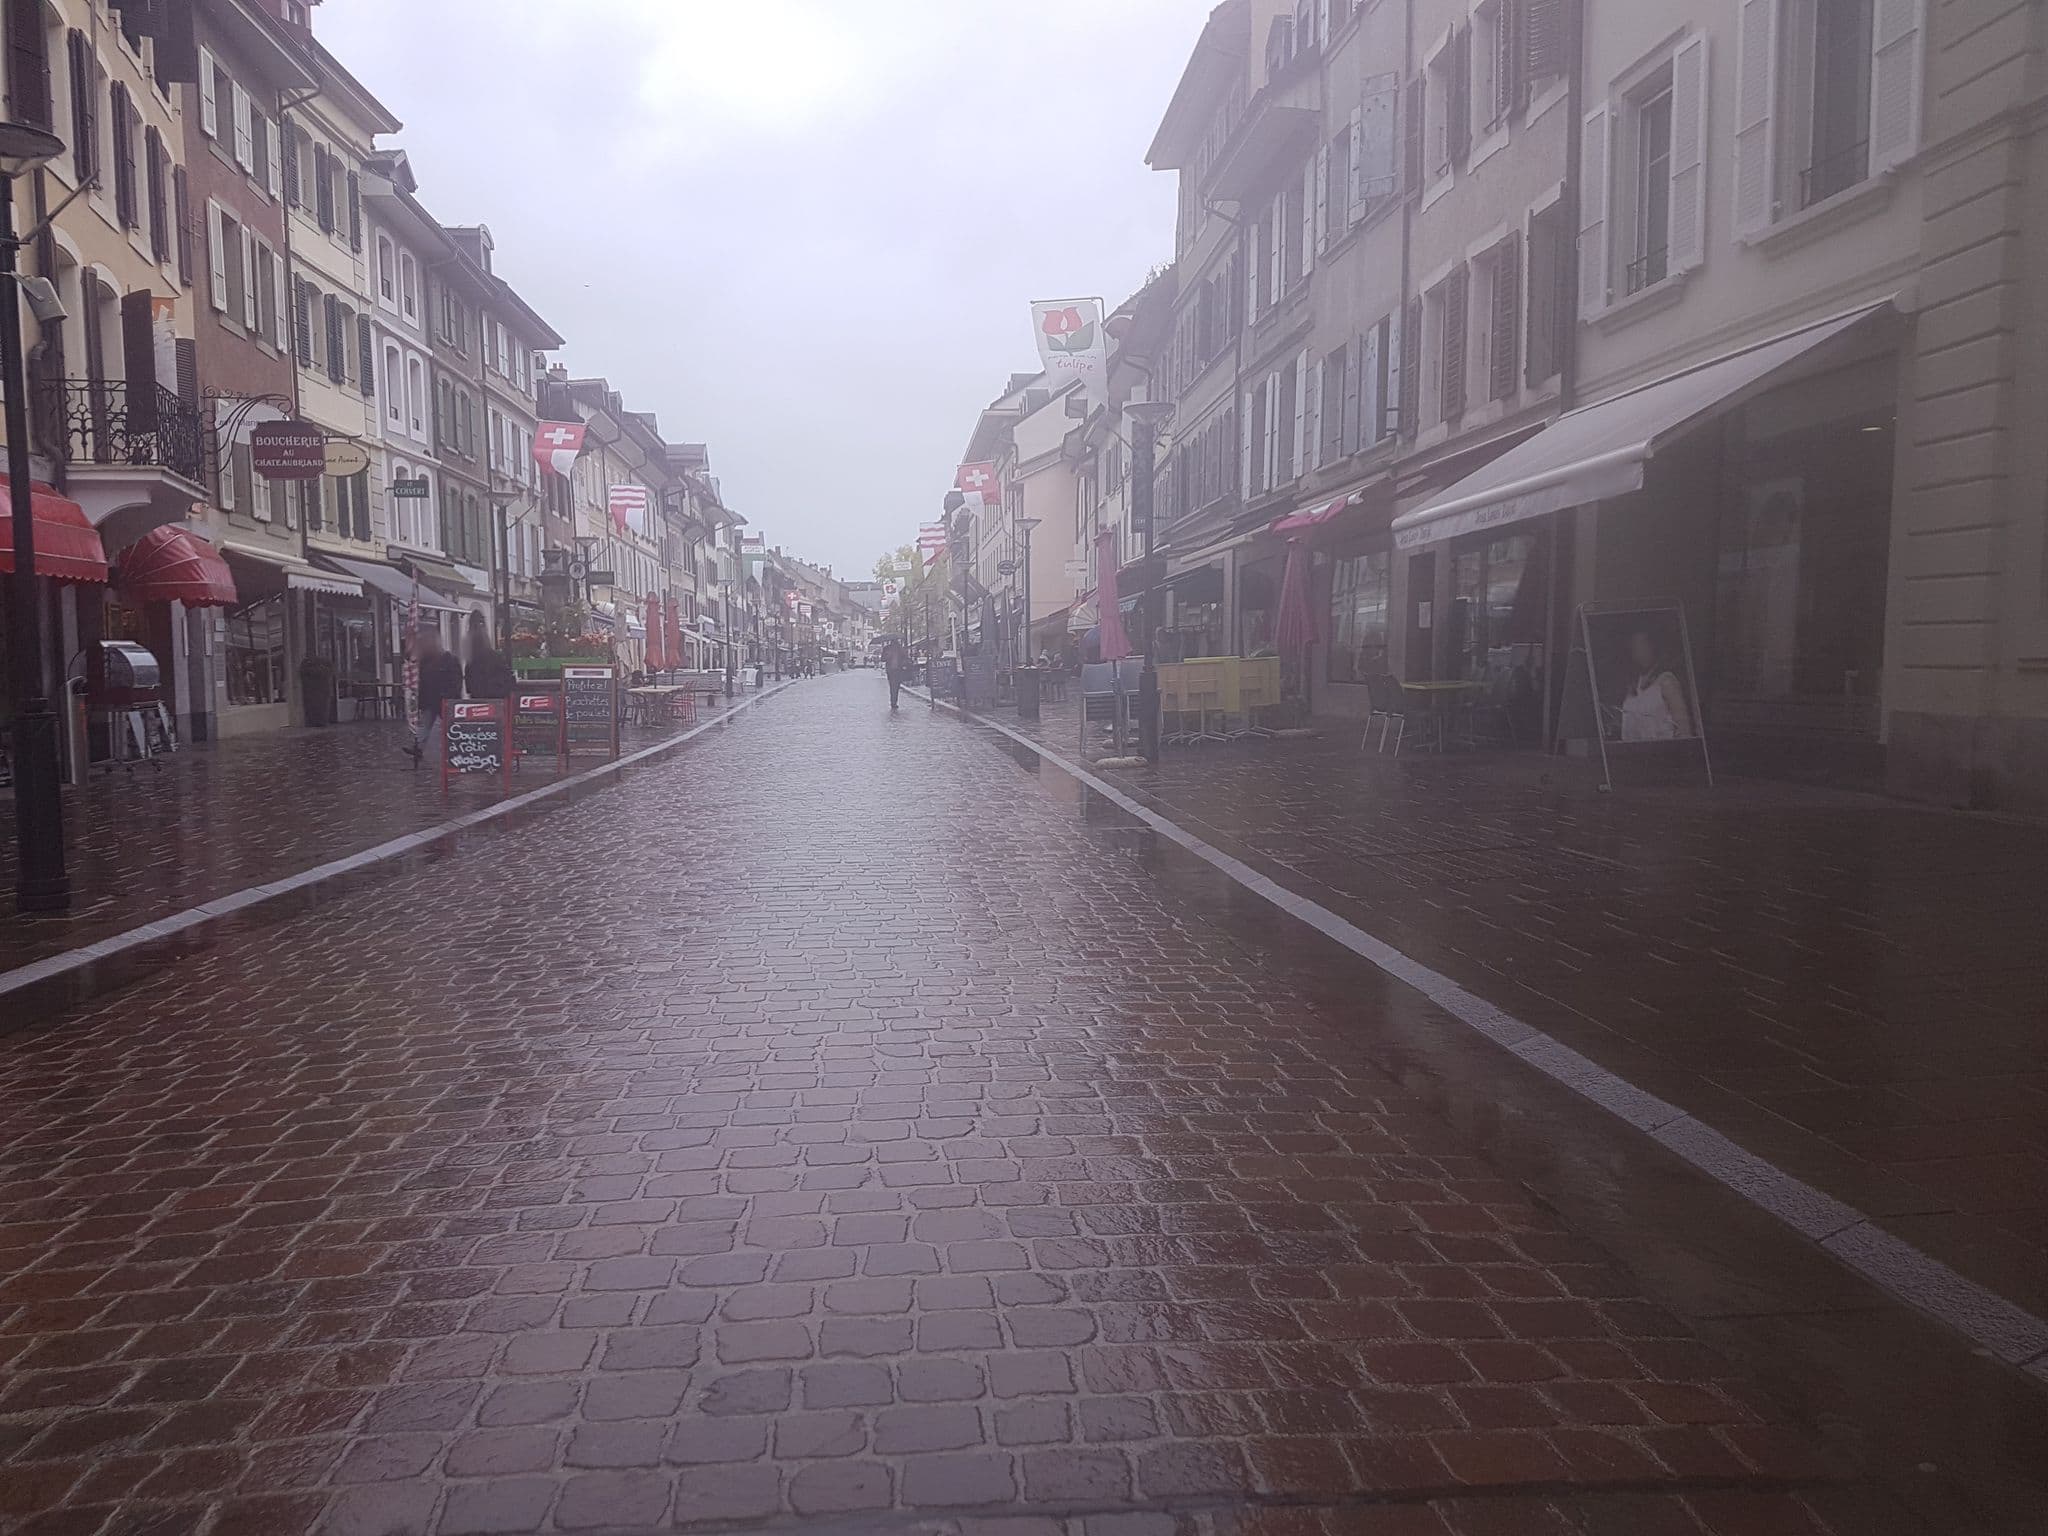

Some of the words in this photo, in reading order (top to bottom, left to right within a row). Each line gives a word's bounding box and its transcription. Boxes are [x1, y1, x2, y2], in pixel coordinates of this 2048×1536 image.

[1056, 359, 1093, 373] tulipe
[255, 436, 321, 447] BOUCHERIE
[255, 459, 323, 467] CHATEAUBRIAND
